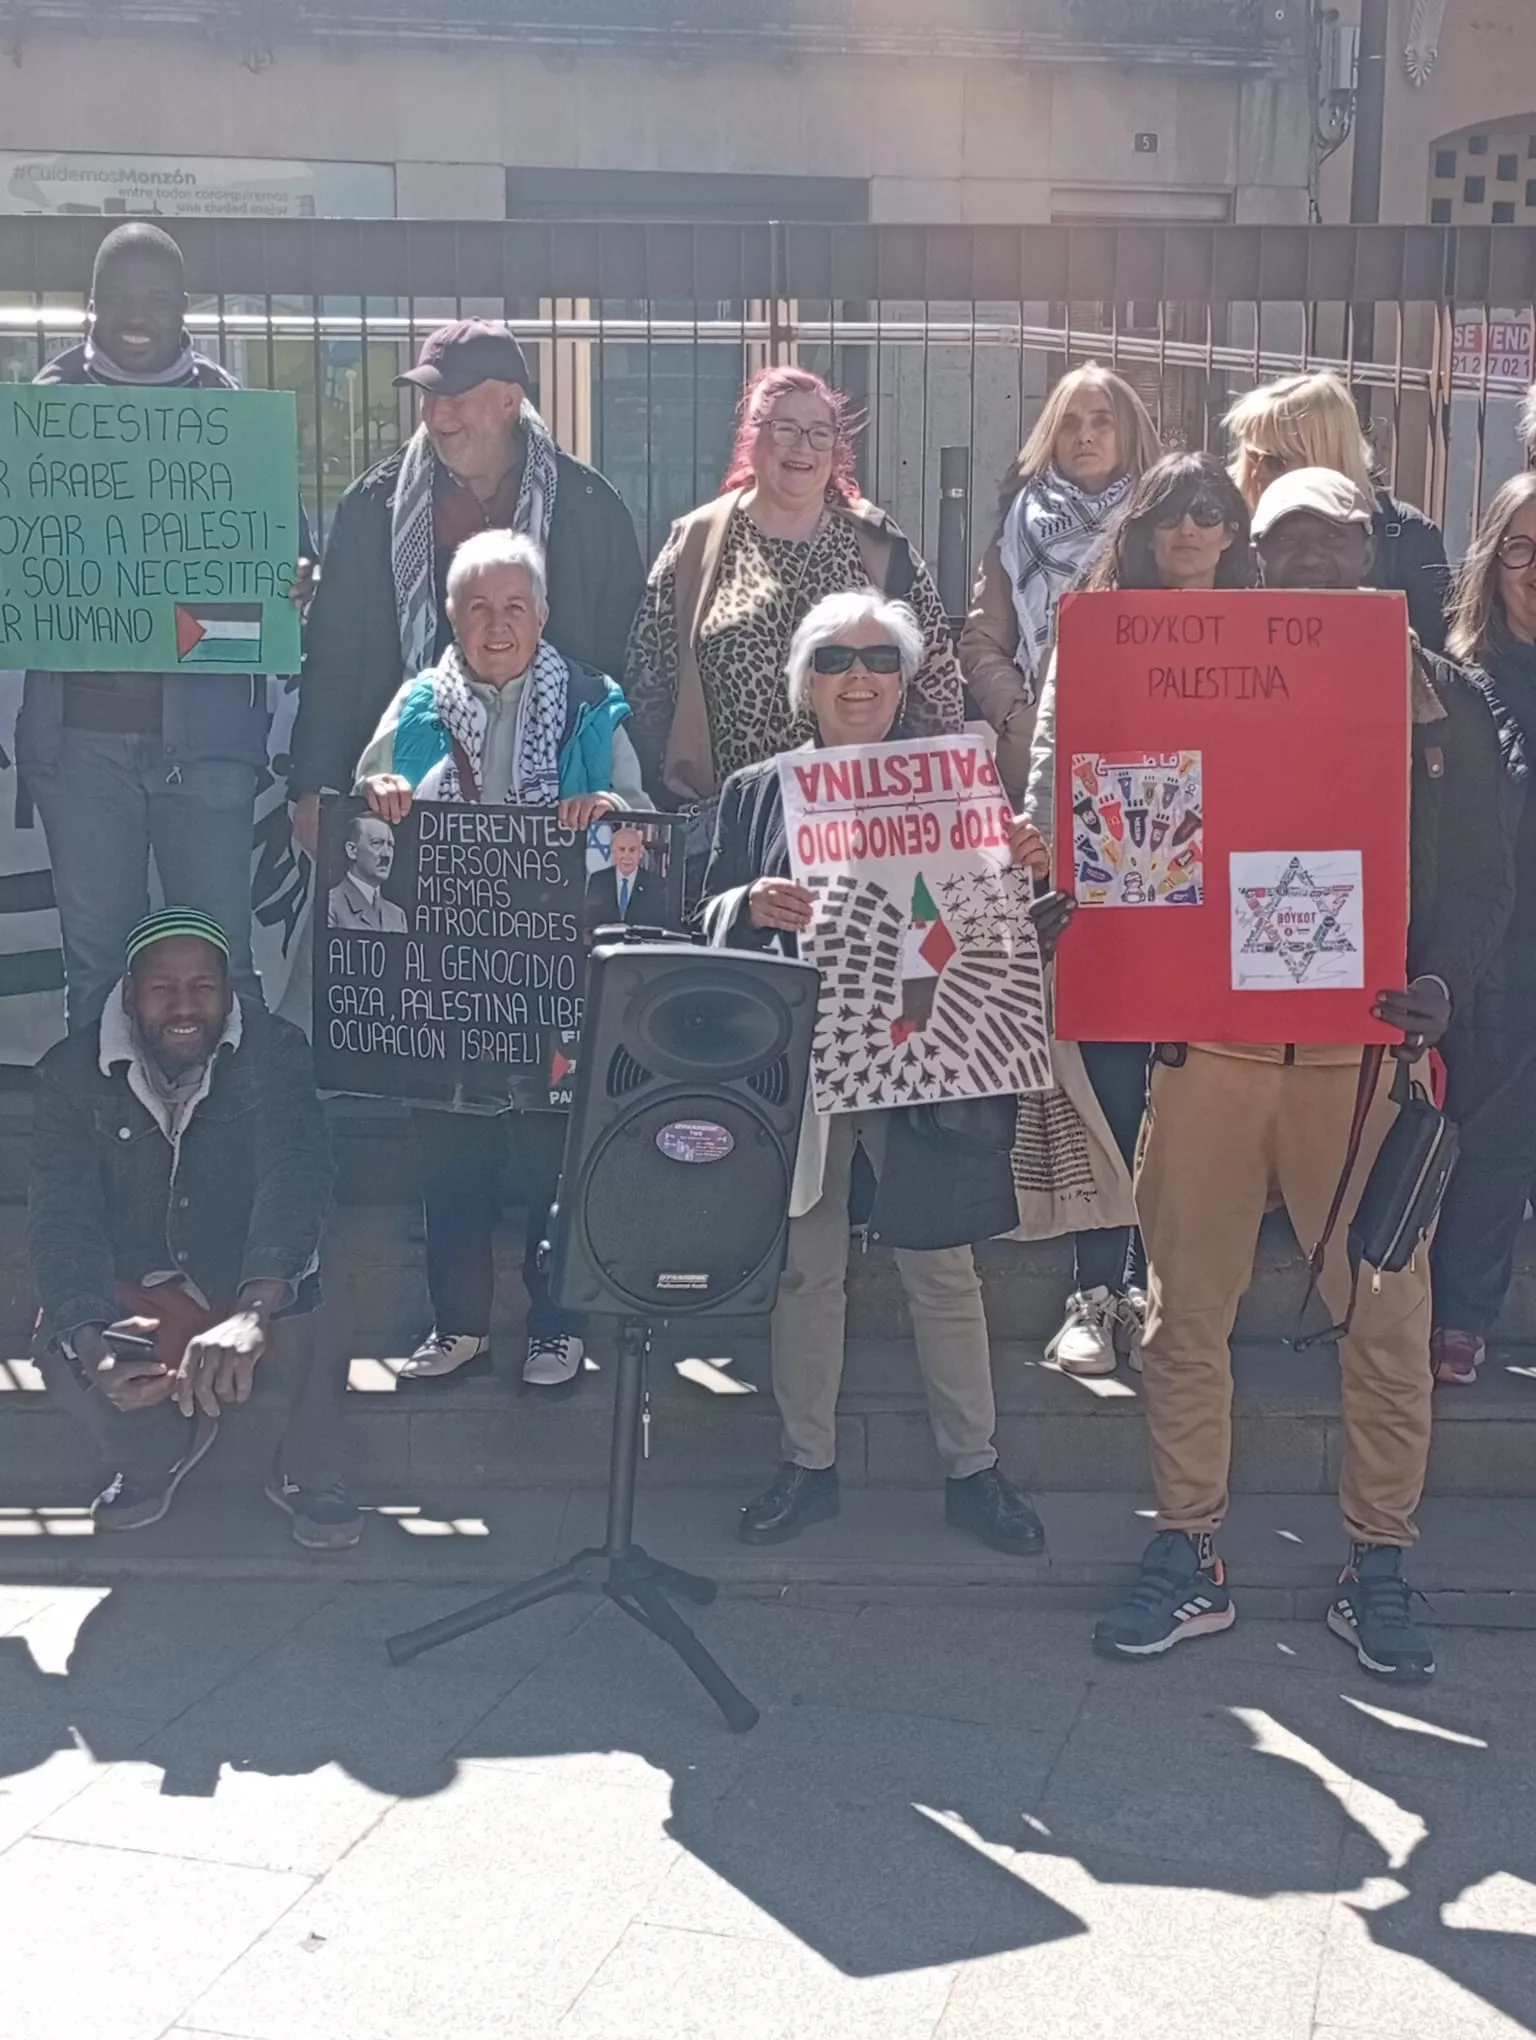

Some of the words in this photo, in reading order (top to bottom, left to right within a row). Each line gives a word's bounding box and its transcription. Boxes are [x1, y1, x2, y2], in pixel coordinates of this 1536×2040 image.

[1454, 325, 1476, 349] SE
[13, 400, 229, 446] NECESITAS
[28, 452, 135, 501] ÁRABE
[148, 458, 233, 501] PARA
[0, 514, 85, 556] OYAR
[105, 514, 128, 555] A
[141, 509, 287, 554] PALESTI-
[21, 556, 102, 599] SOLO
[116, 560, 297, 599] NECESITAS
[0, 603, 21, 642] R
[34, 603, 154, 644] HUMANO
[1115, 614, 1225, 645] BOYKOT
[1268, 617, 1323, 648] FOR
[1147, 666, 1291, 700] PALESTINA
[793, 748, 1000, 803] PALESTINA
[419, 811, 576, 847] DIFERENTES
[797, 812, 941, 865] GENOCIDIO
[950, 805, 1014, 851] STOP
[418, 844, 569, 887] PERSONAS,
[417, 876, 512, 908] MISMAS
[415, 905, 577, 942] ATROCIDADES
[1277, 912, 1317, 924] BOYKOT
[328, 938, 386, 978] ALTO
[405, 941, 432, 983] AL
[441, 944, 576, 991] GENOCIDIO
[401, 987, 528, 1025] PALESTINA
[461, 1029, 540, 1065] ISRAELI
